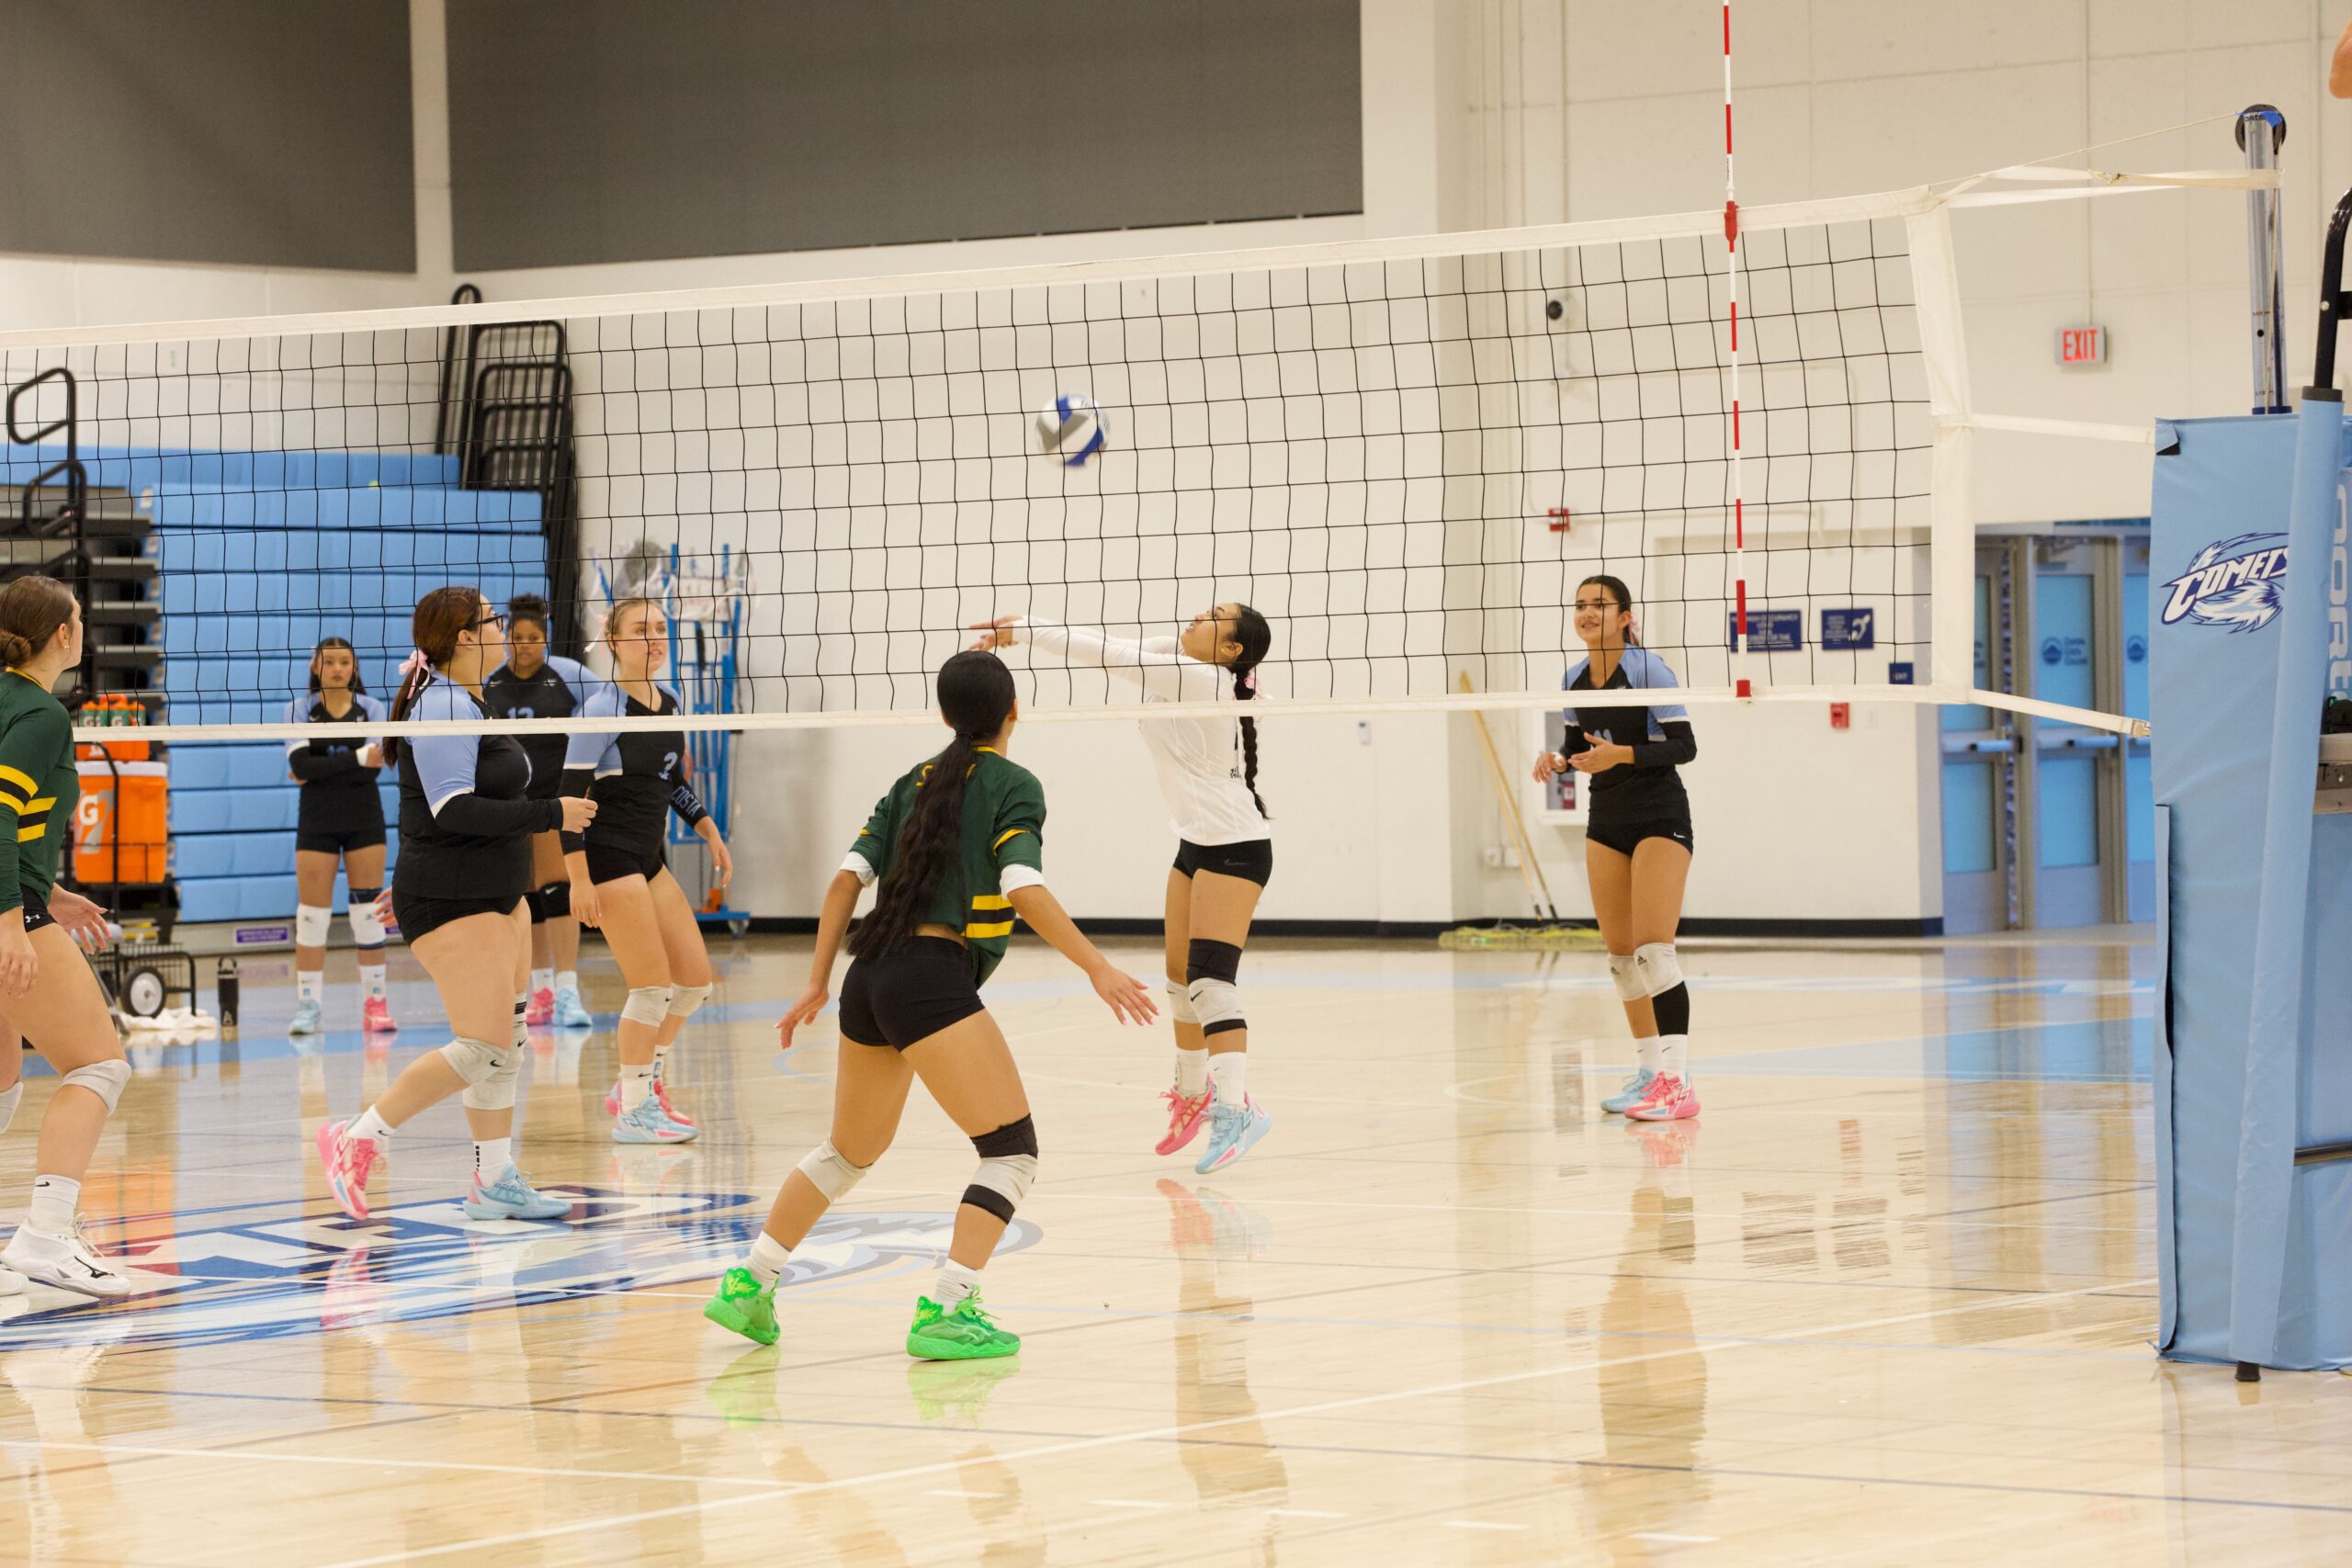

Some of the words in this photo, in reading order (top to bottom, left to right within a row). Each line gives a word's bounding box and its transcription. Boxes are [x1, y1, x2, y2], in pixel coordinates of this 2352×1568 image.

[2063, 328, 2098, 362] EXIT
[79, 794, 98, 826] G
[671, 785, 702, 817] COSTA
